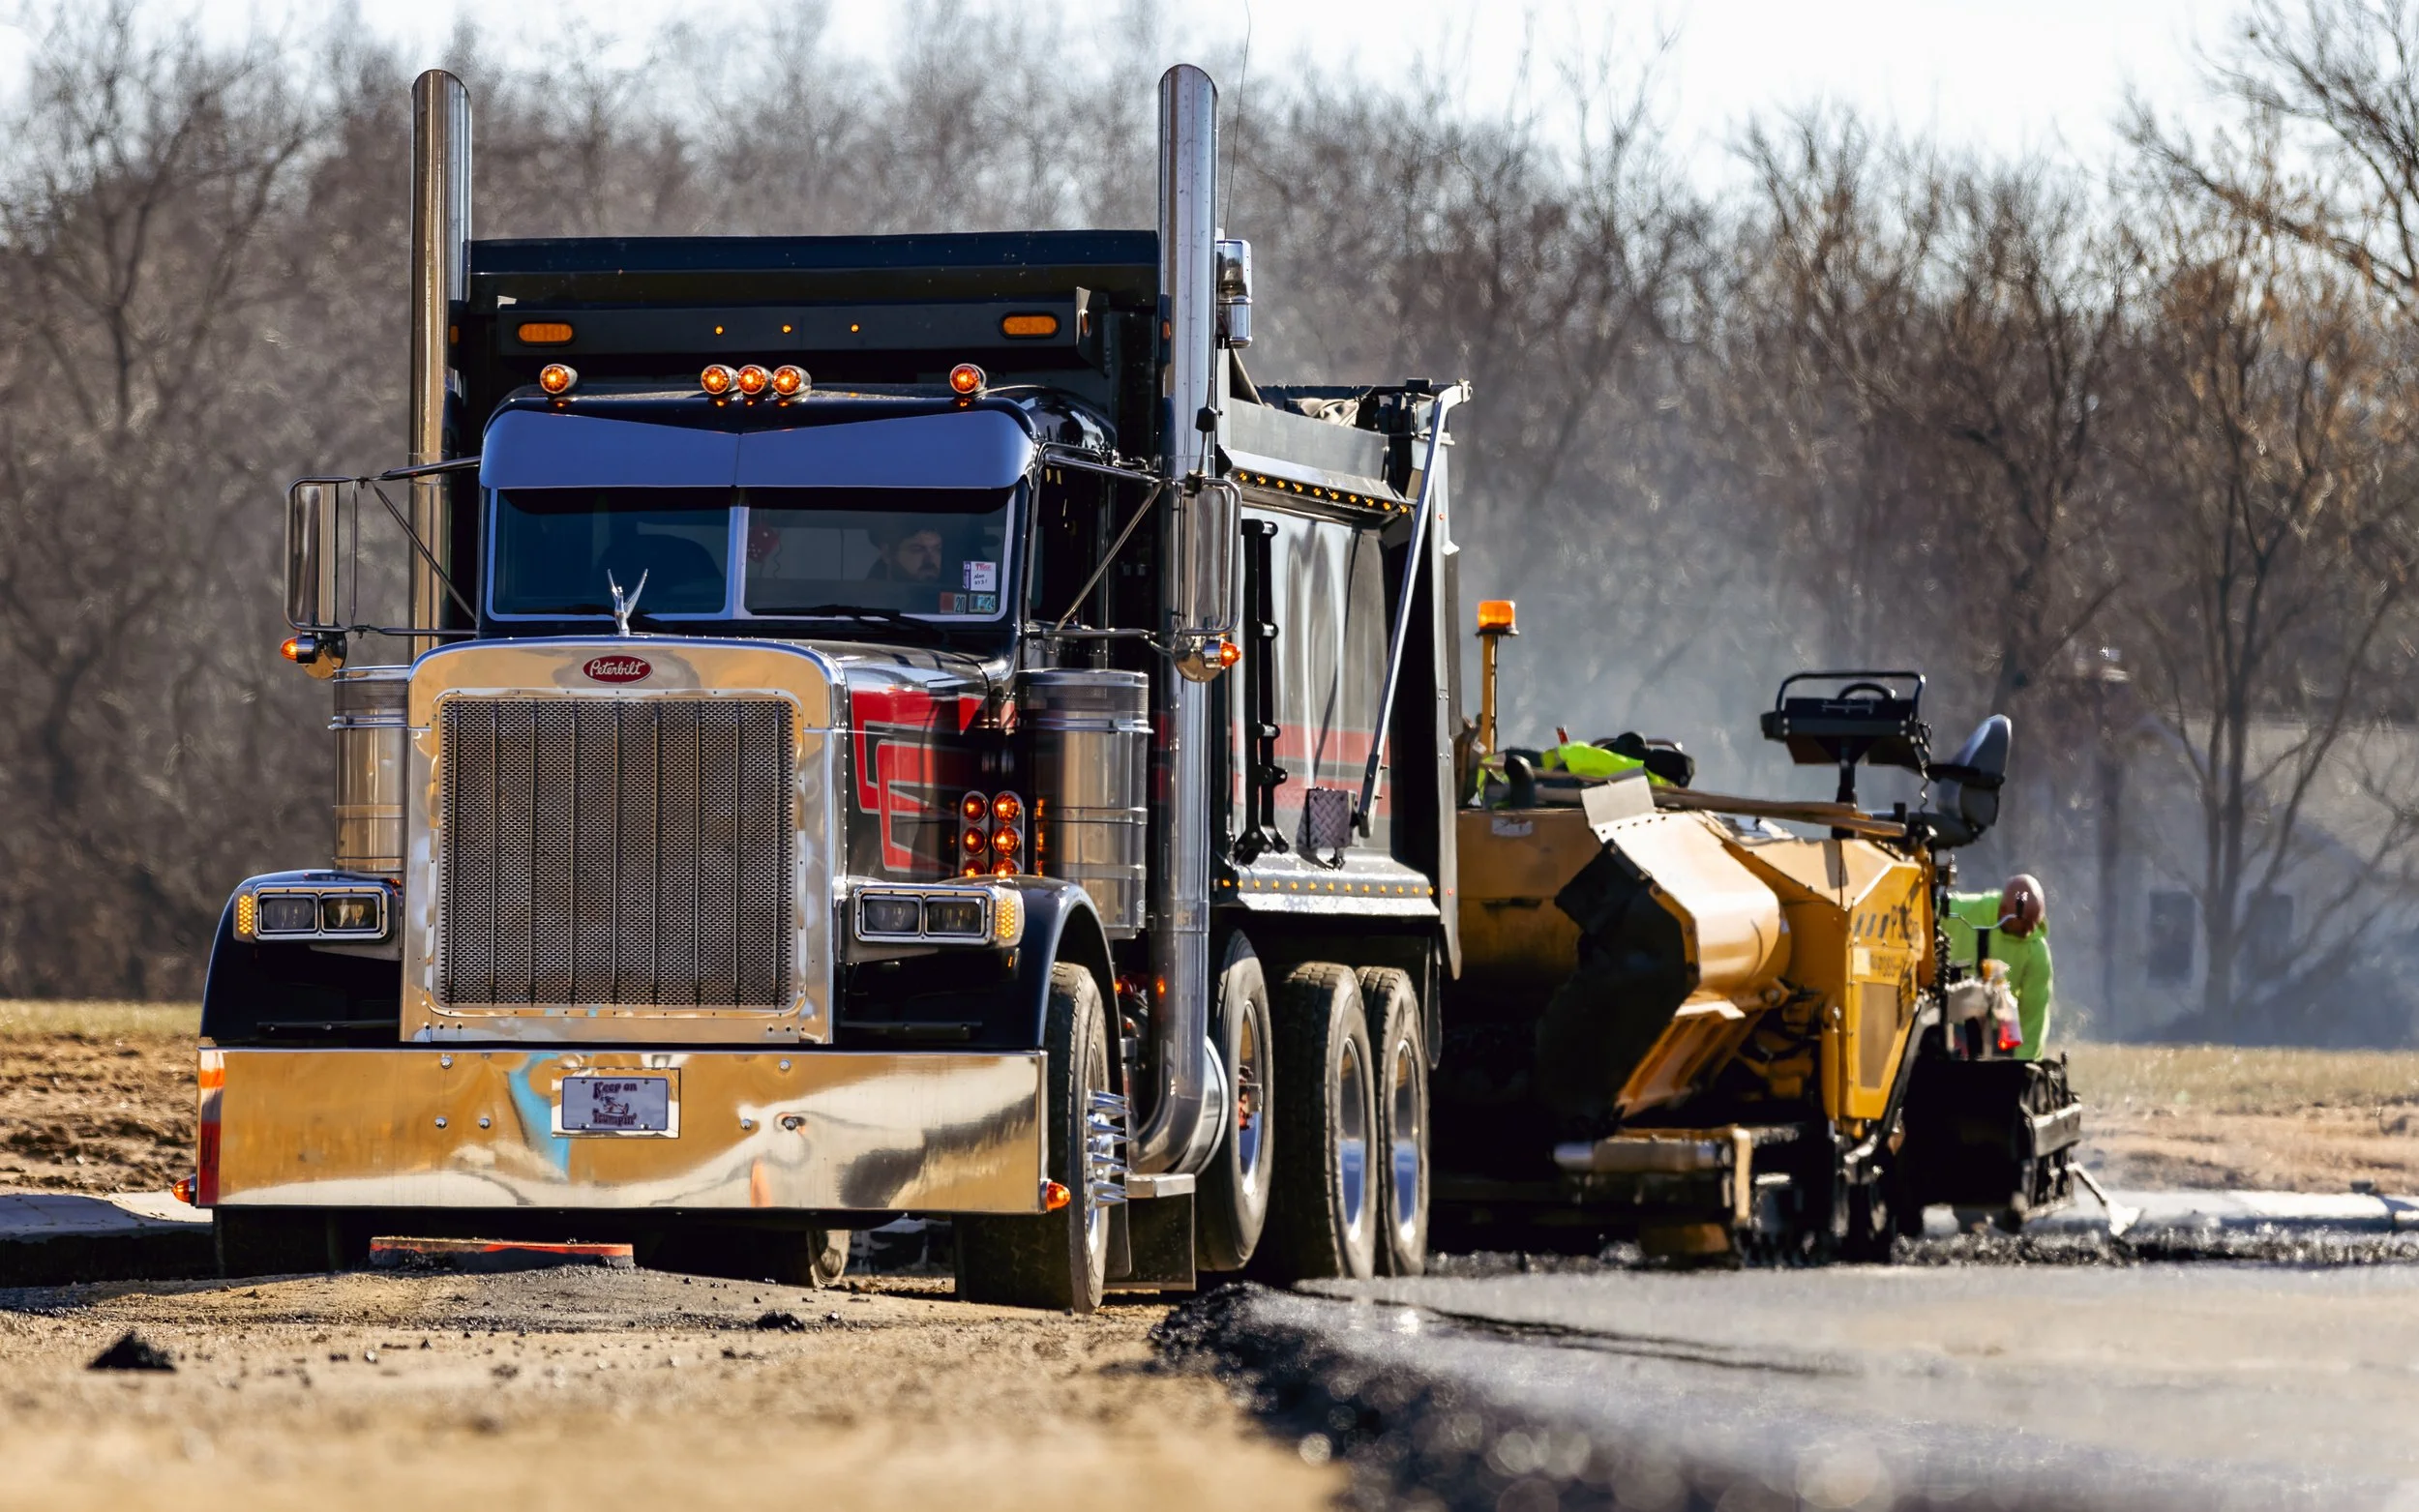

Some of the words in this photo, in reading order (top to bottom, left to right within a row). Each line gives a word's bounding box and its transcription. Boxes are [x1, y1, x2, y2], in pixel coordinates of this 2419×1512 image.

[589, 660, 645, 676] Peterbilt
[592, 1081, 621, 1100] Keep
[623, 1082, 638, 1092] on
